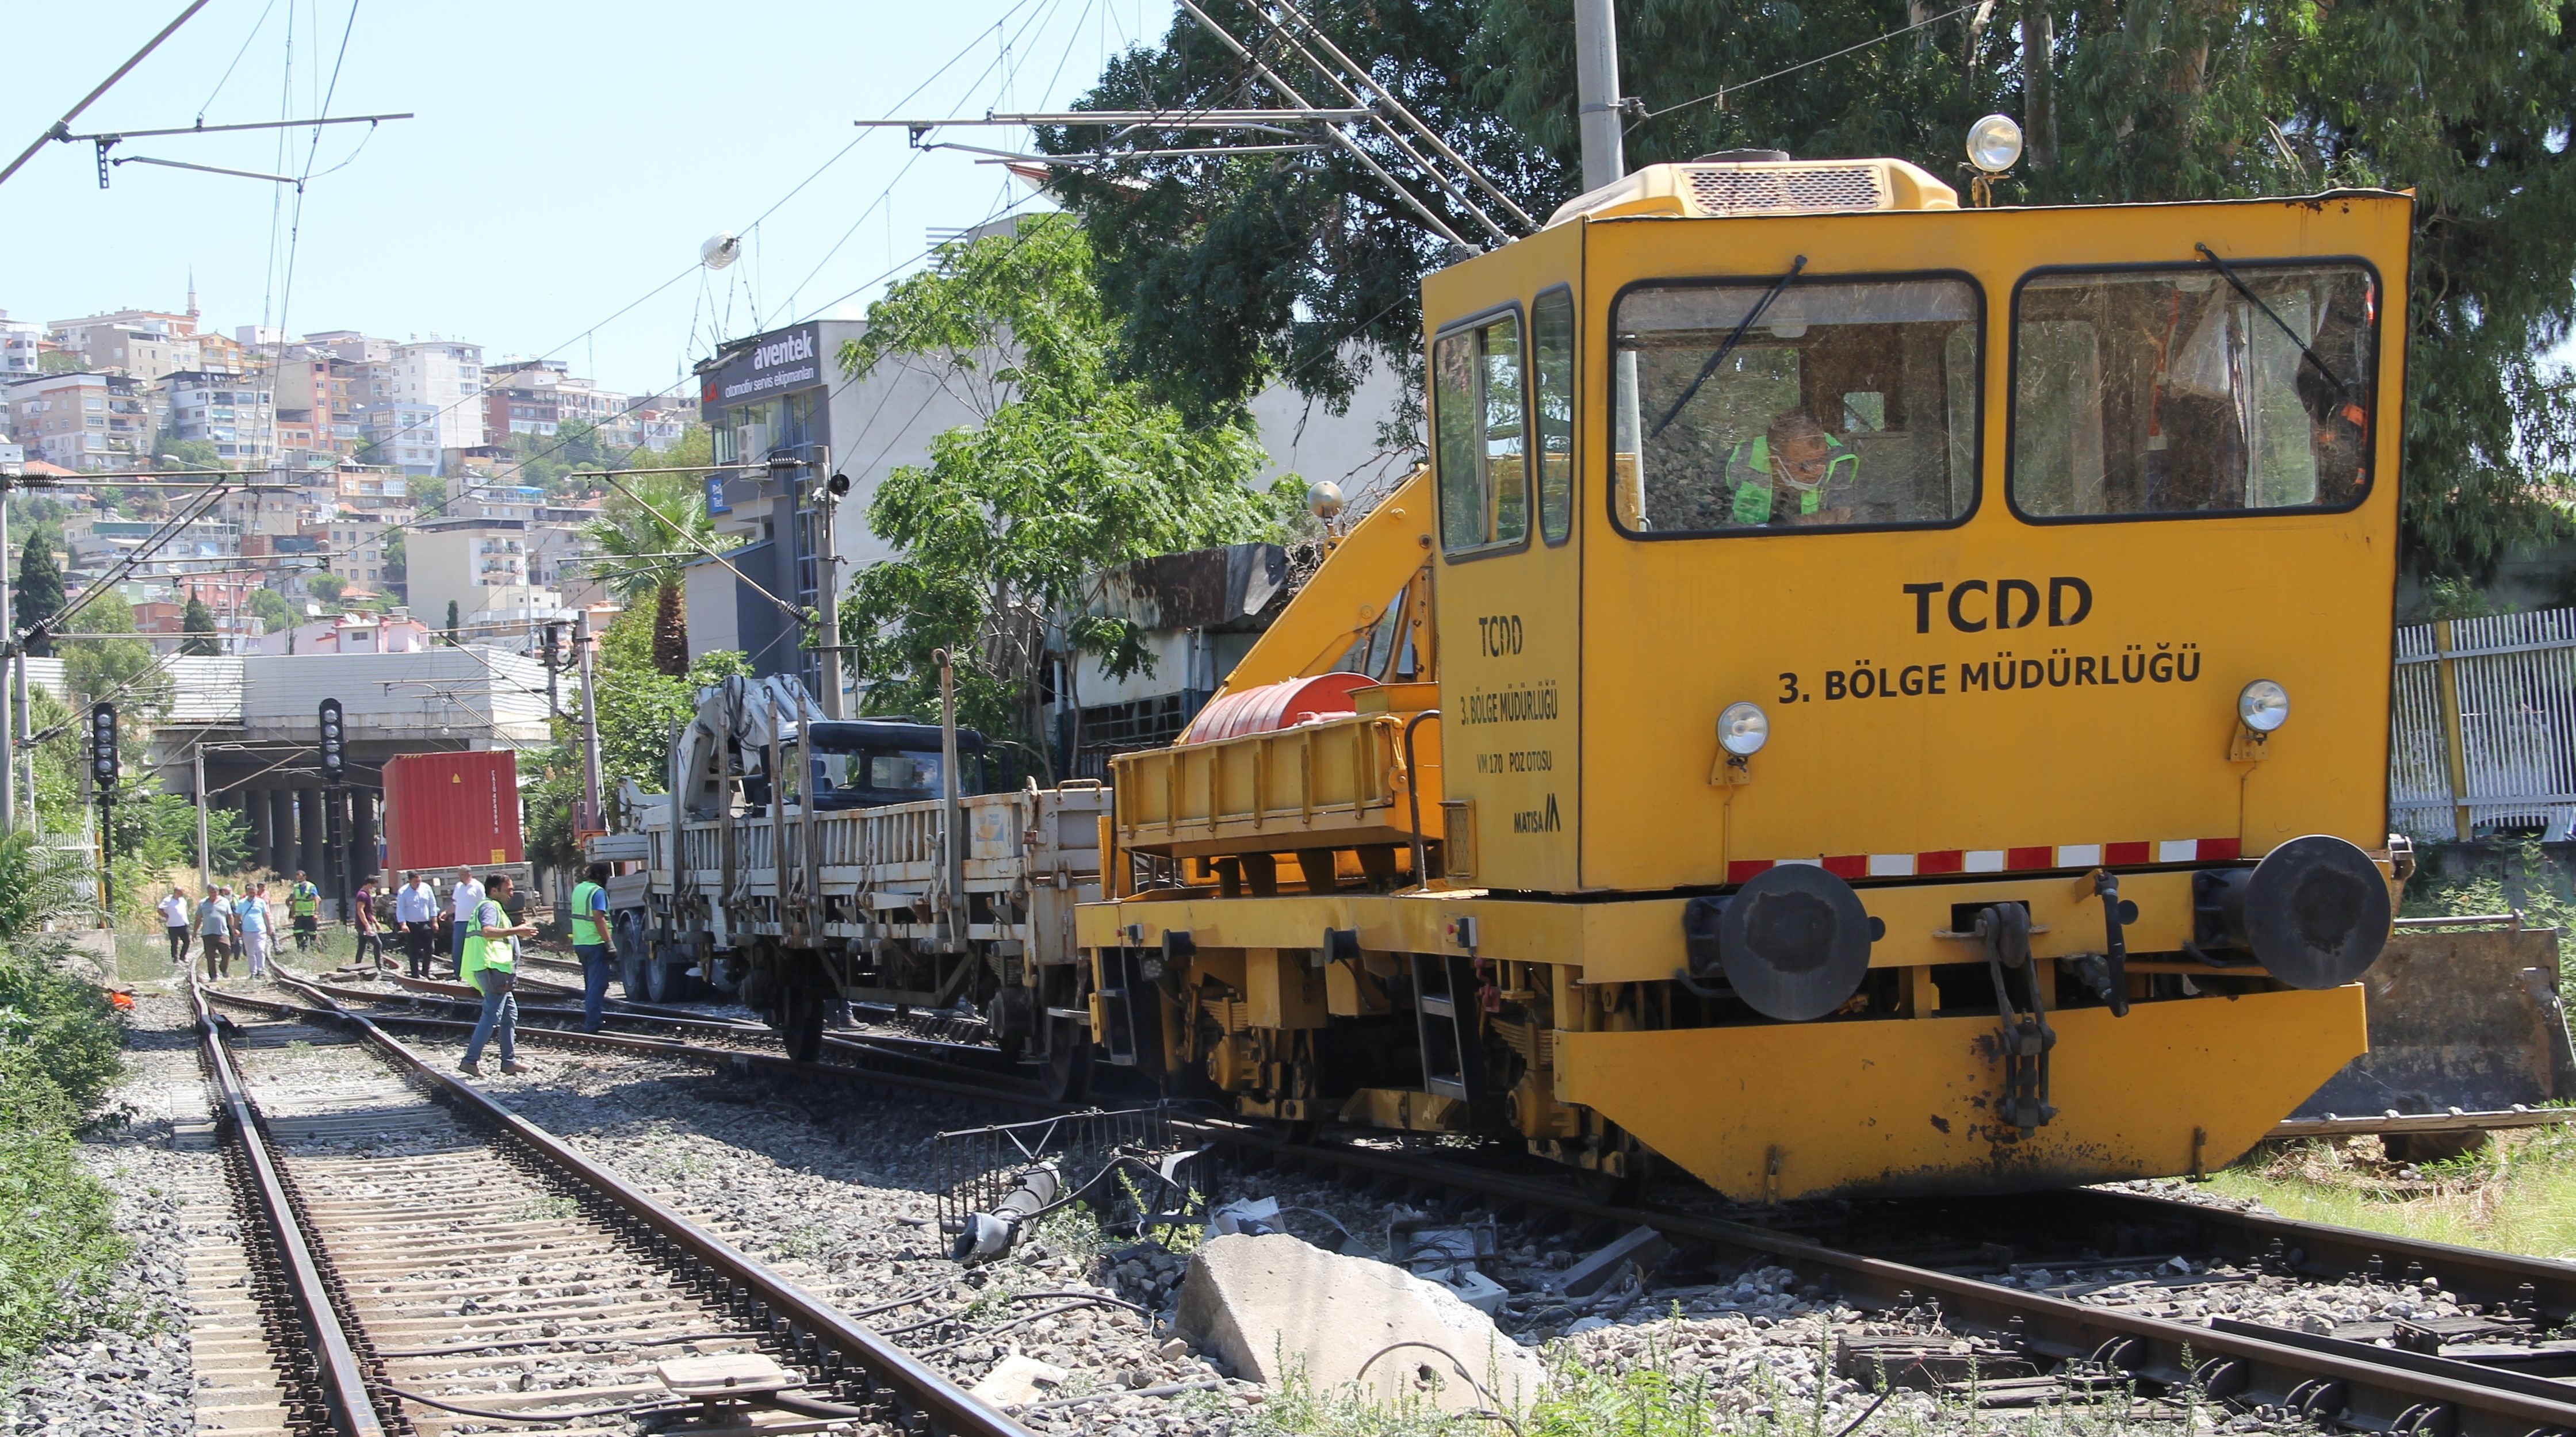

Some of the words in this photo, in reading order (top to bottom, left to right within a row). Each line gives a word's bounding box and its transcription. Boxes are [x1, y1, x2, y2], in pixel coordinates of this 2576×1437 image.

[754, 330, 813, 370] aventek
[725, 379, 753, 398] otomotiv
[753, 374, 774, 391] servis
[1903, 577, 2093, 634] TCDD
[1479, 615, 1522, 657] TCDD
[1778, 672, 1810, 704] 3.
[1825, 659, 1946, 700] BÖLGE
[1961, 642, 2200, 692] MÜDÜRLÜĞÜ
[1460, 696, 1469, 726] 3.
[1470, 686, 1498, 725] BÖLGE
[1500, 679, 1557, 722] MÜDÜRLÜĞÜ
[1476, 754, 1488, 773] VM
[1489, 753, 1503, 773] 170
[1509, 752, 1525, 772] POZ
[1526, 750, 1552, 771] OTOSU
[1514, 811, 1544, 834] MATISA
